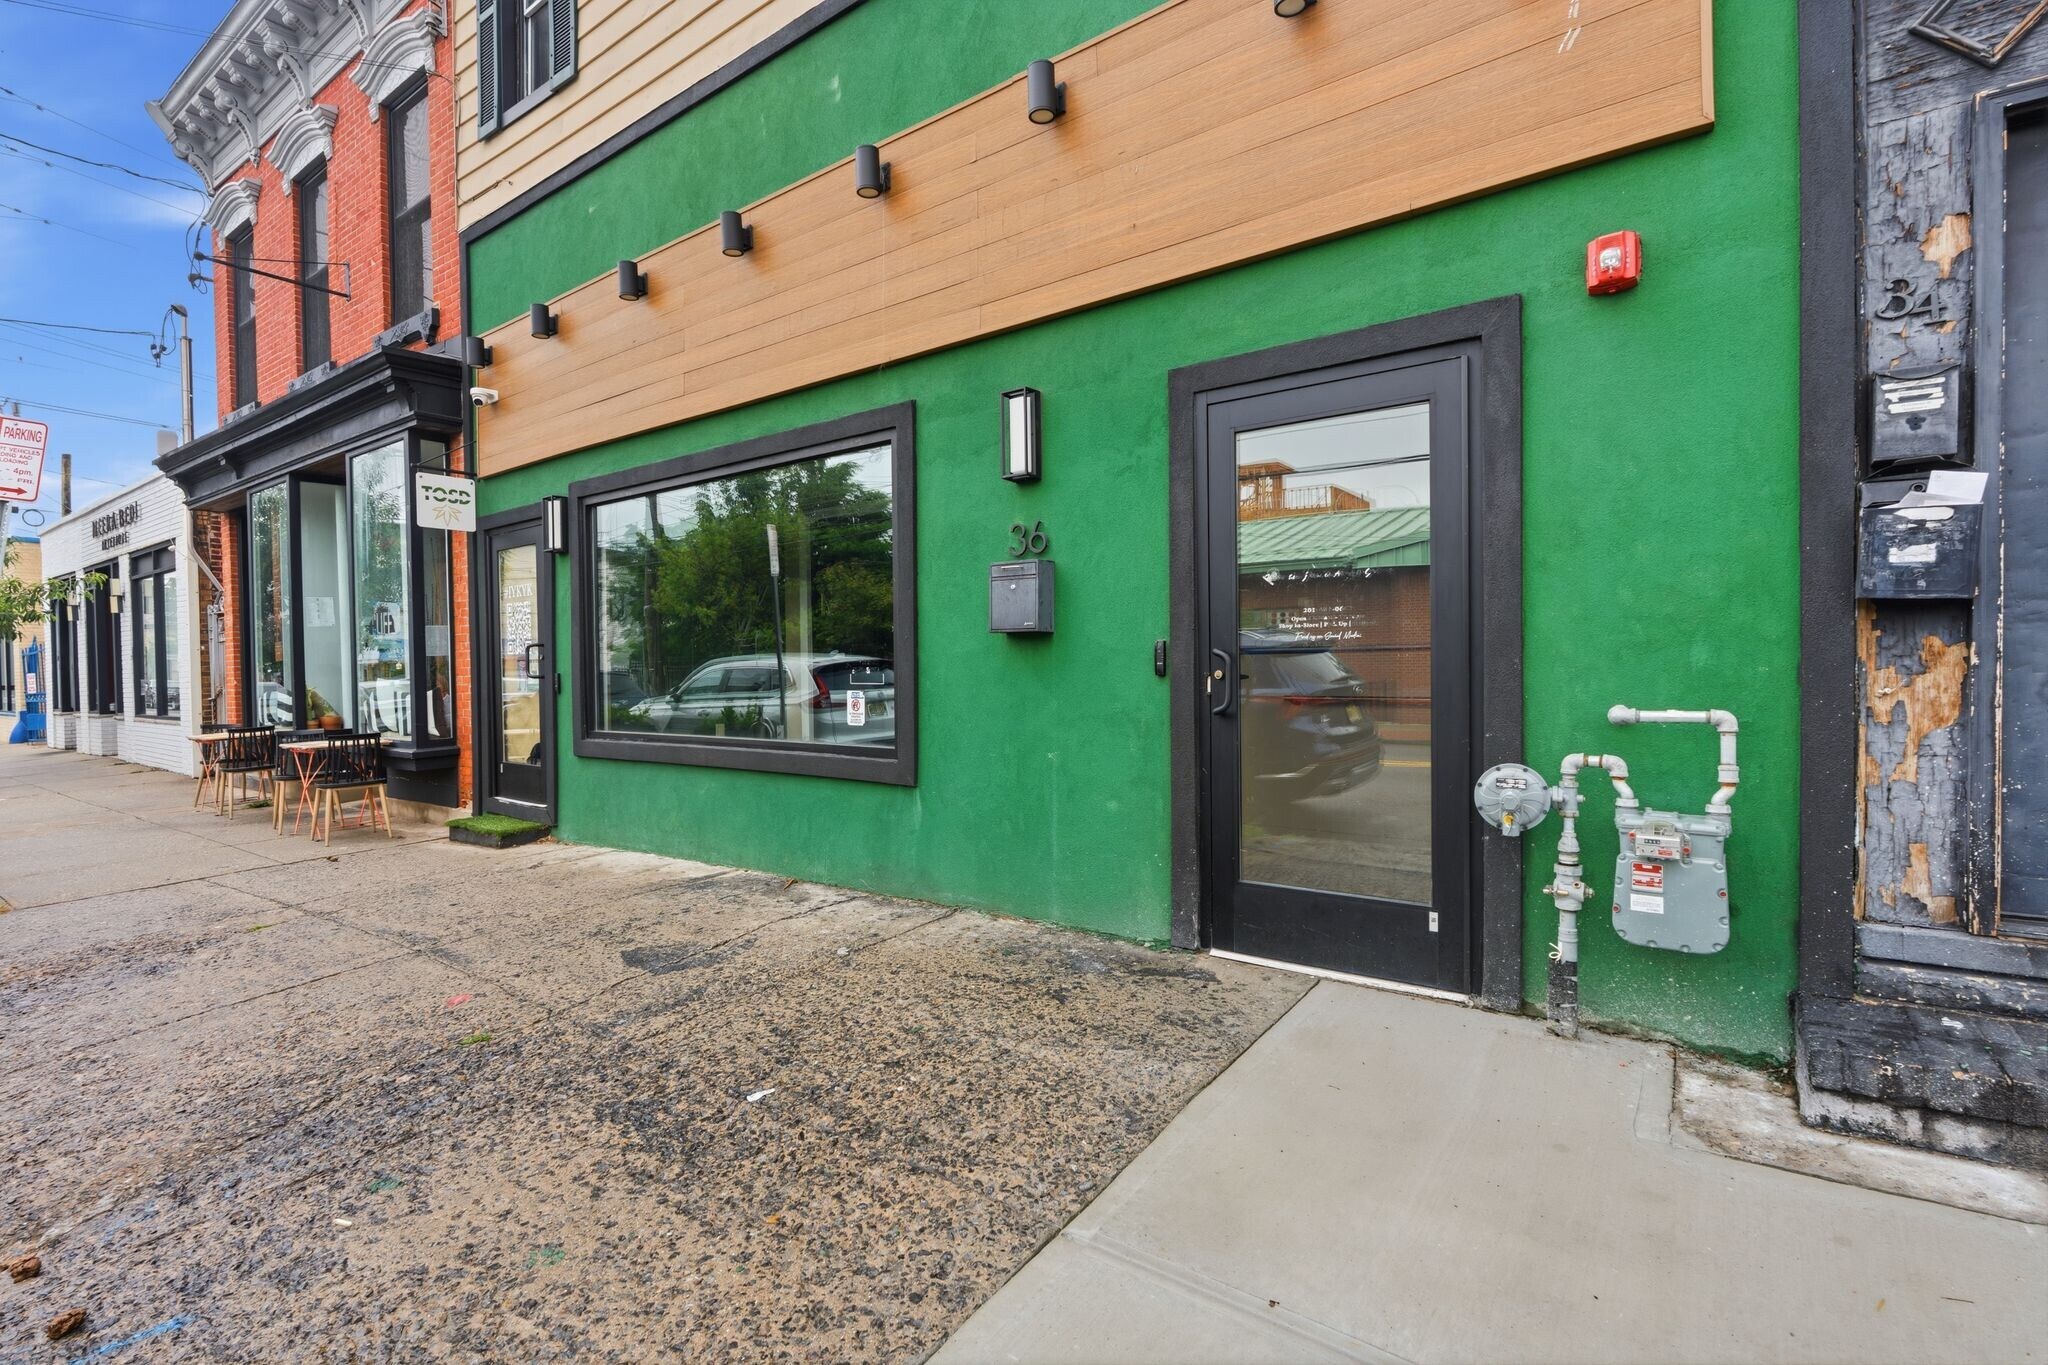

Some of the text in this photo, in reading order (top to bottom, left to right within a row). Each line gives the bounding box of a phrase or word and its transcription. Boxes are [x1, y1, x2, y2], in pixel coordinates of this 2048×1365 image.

[1876, 279, 1948, 326] 34
[3, 426, 42, 443] PARKING
[9, 448, 41, 456] VEHICLES
[421, 485, 472, 505] TOSD
[1008, 520, 1048, 557] 36
